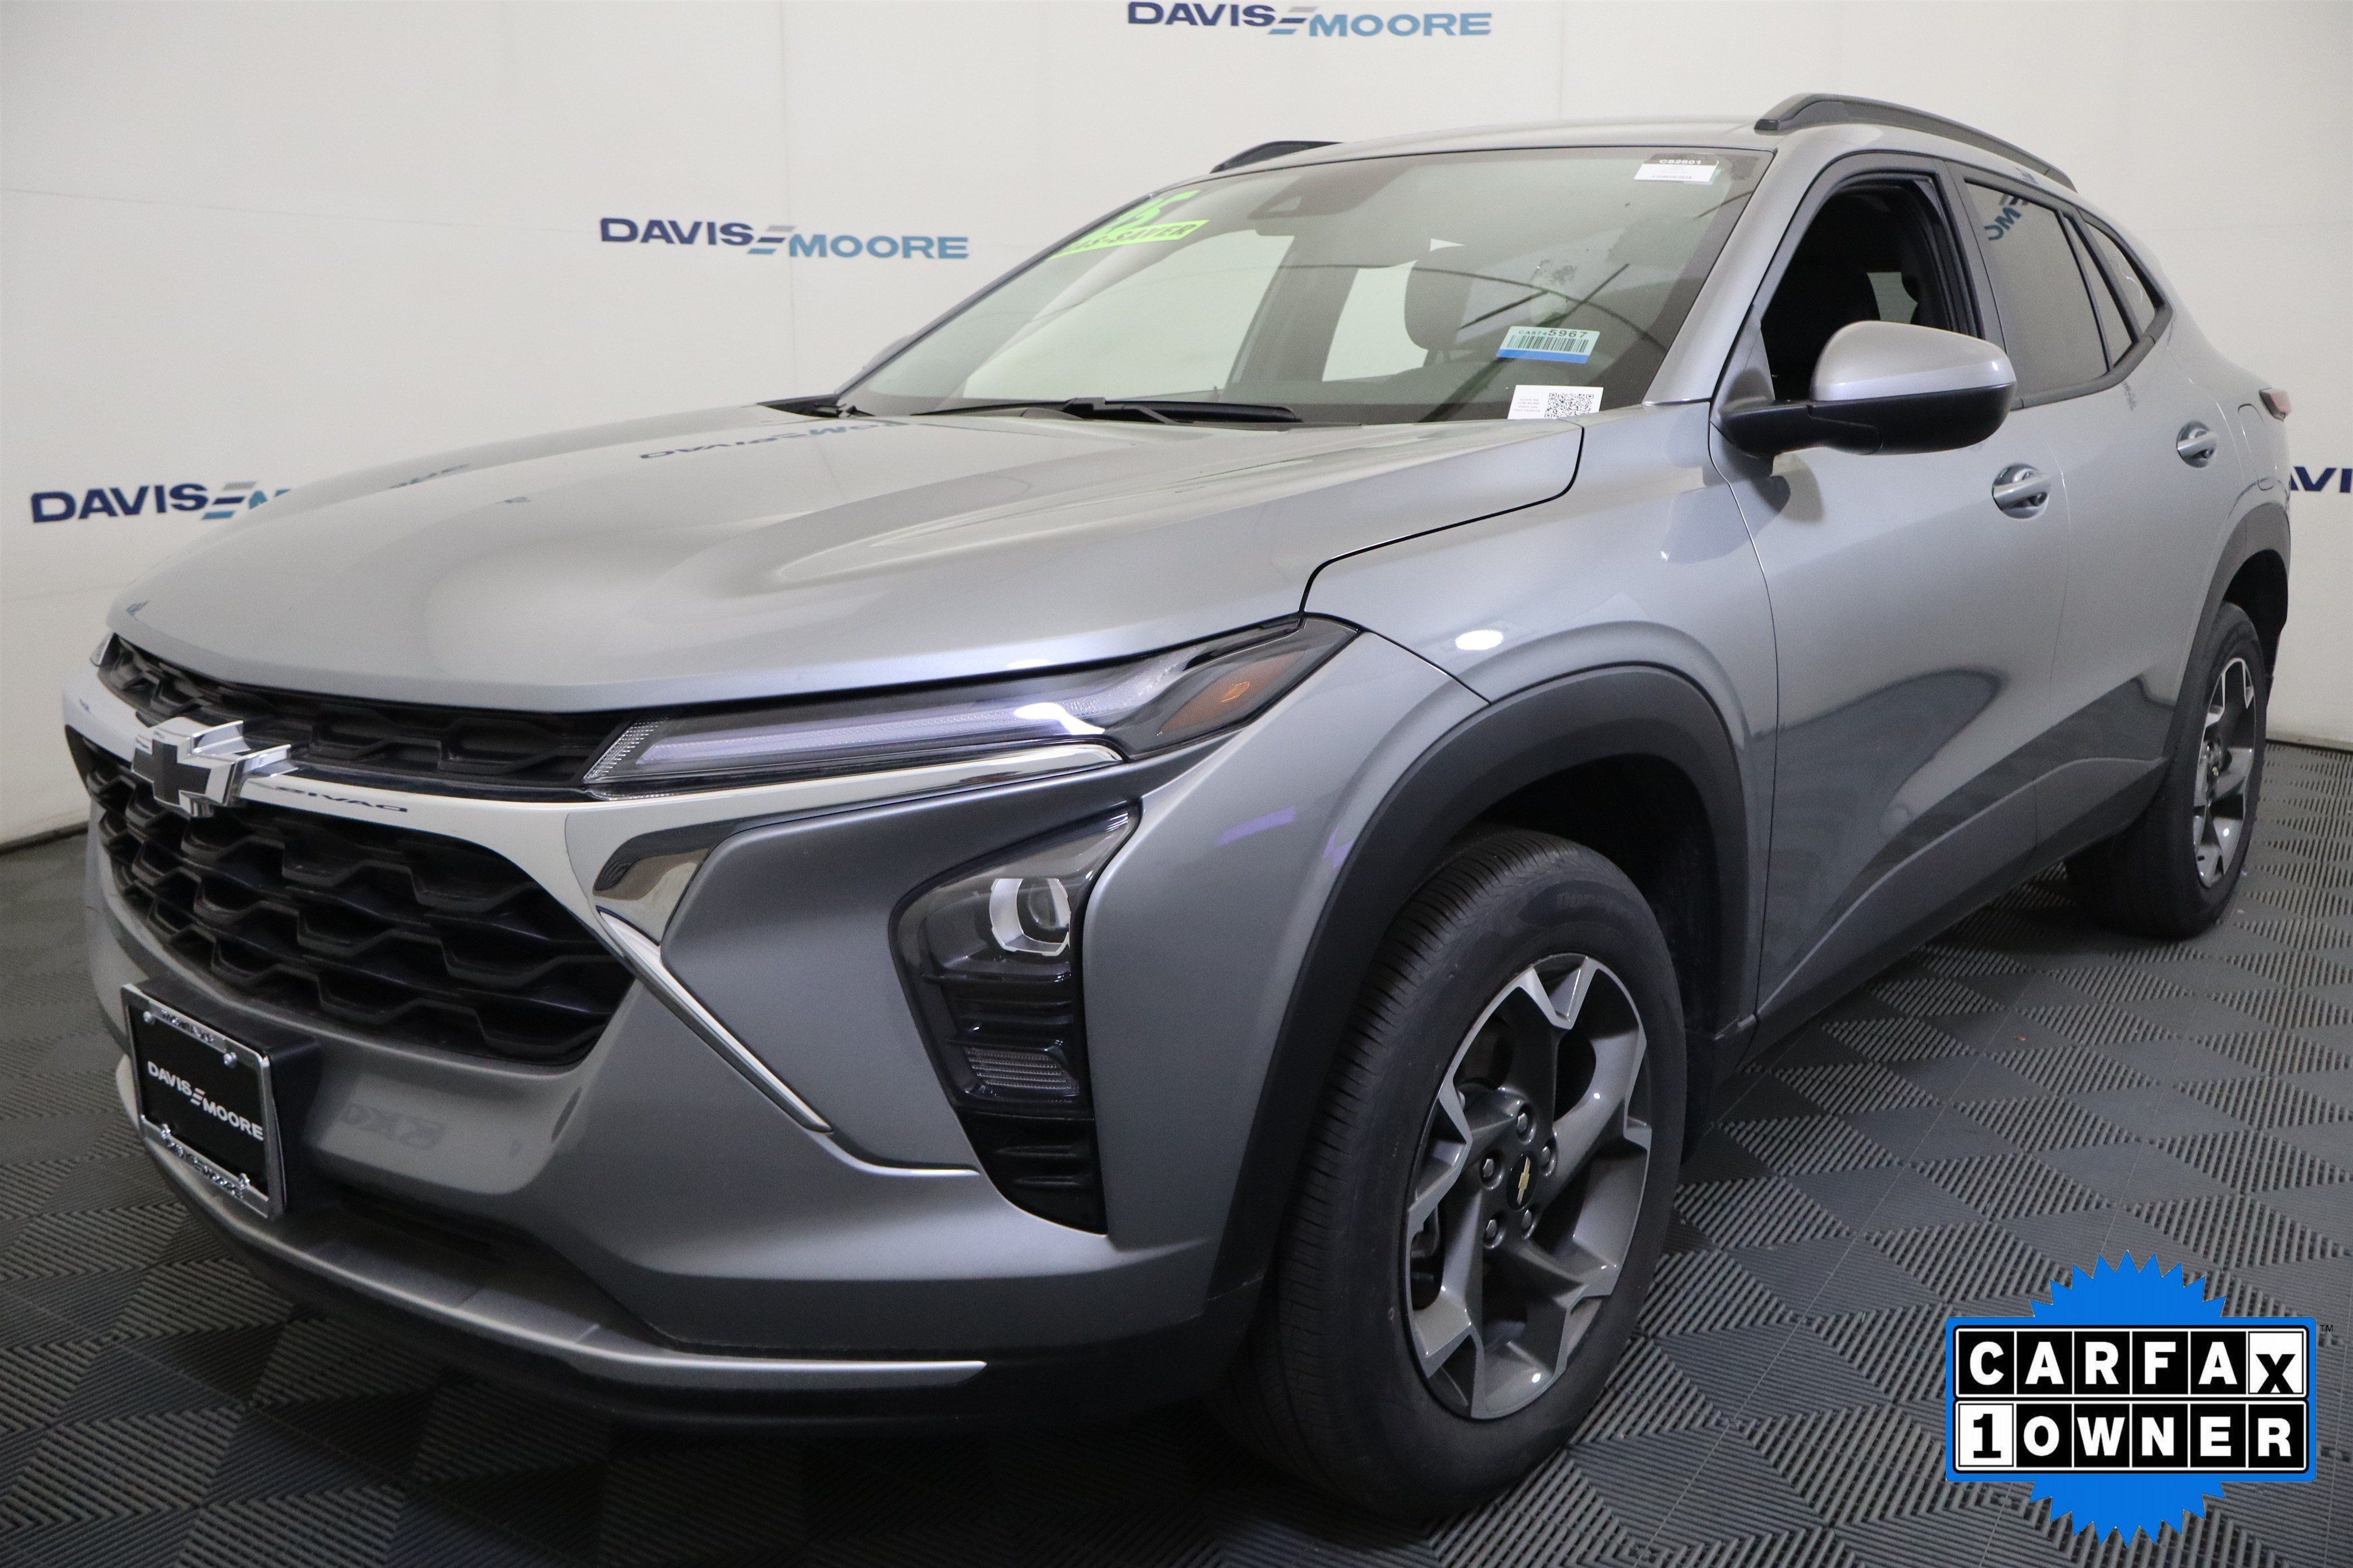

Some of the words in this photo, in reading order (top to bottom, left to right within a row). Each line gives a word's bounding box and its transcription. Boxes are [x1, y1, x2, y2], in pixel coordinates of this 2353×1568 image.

[1127, 1, 1276, 28] DAVIS
[1309, 13, 1492, 37] MOORE
[599, 217, 754, 246] DAVIS
[788, 233, 969, 260] MOORE
[29, 482, 210, 524] DAVIS
[146, 1060, 192, 1098] DAVIS
[202, 1096, 264, 1141] MOORE
